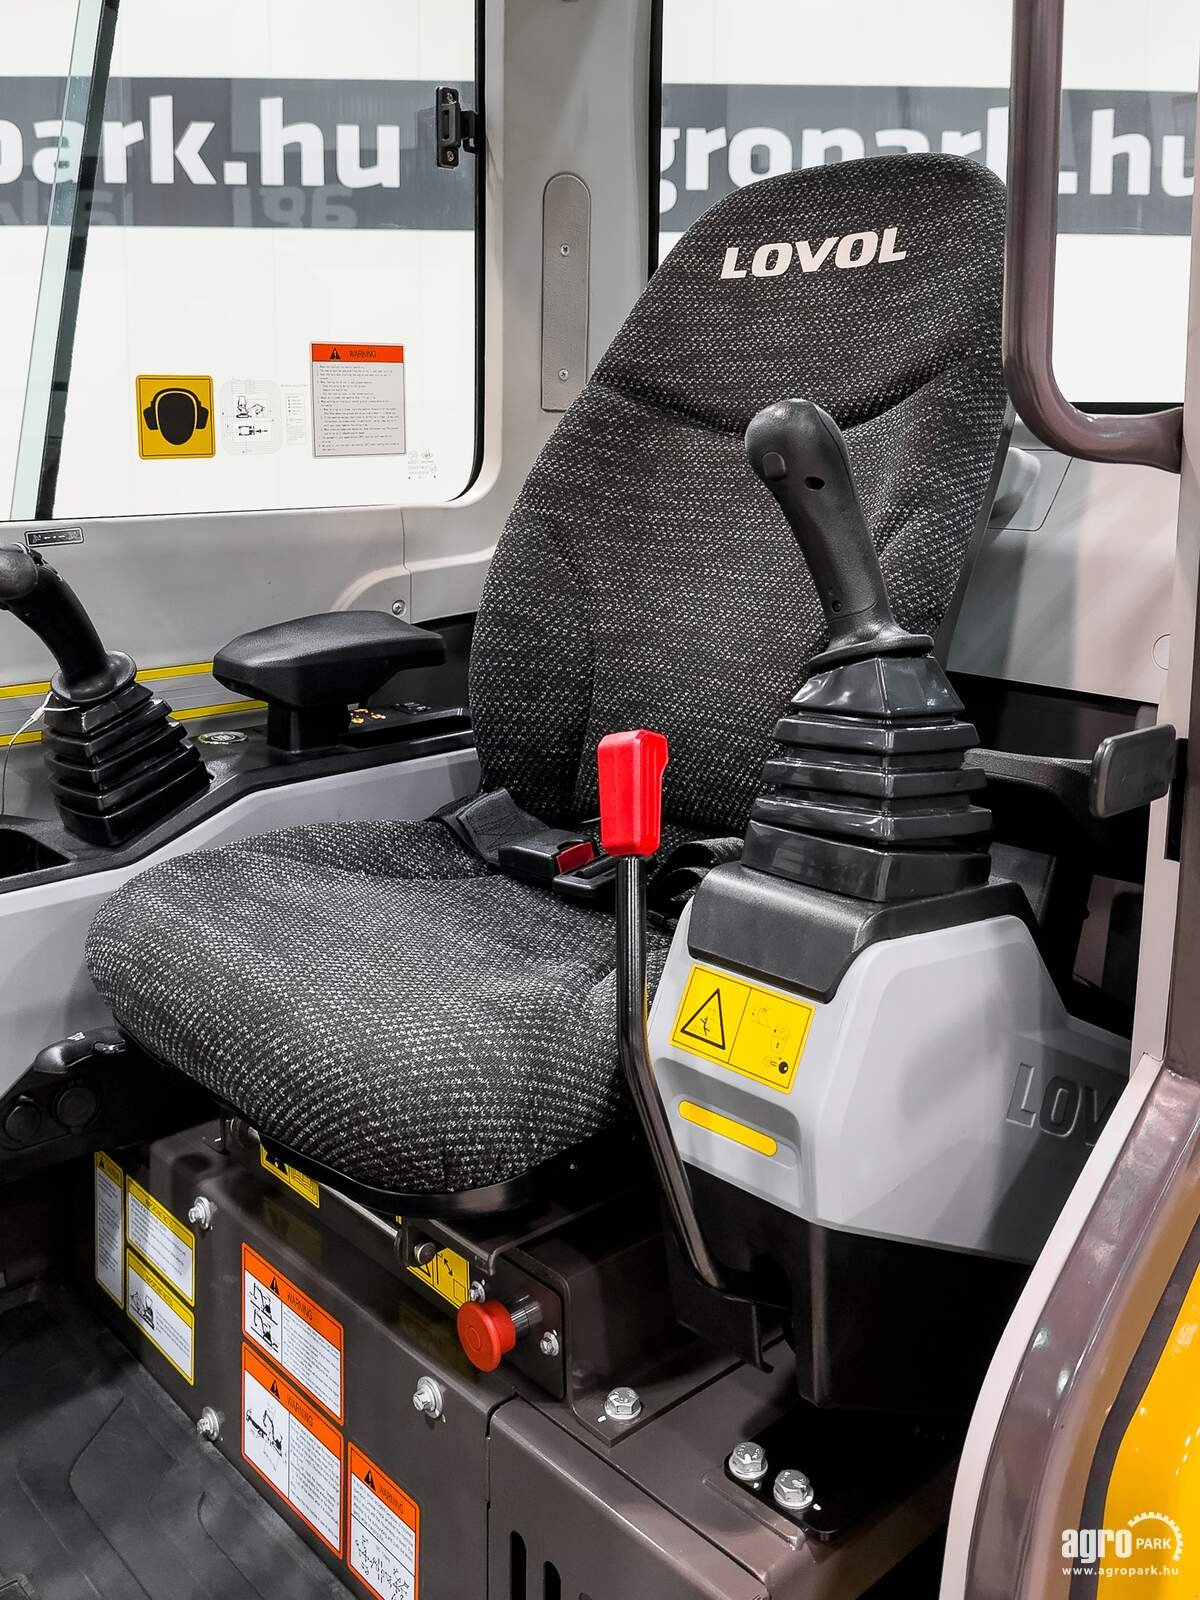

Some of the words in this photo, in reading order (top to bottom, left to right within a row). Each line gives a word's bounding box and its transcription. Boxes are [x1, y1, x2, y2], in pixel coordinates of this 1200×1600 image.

[721, 227, 907, 280] LOVOL
[348, 349, 377, 359] WARNING
[286, 1289, 314, 1322] WARNING
[286, 1394, 314, 1427] WARNING
[378, 1484, 404, 1515] WARNING
